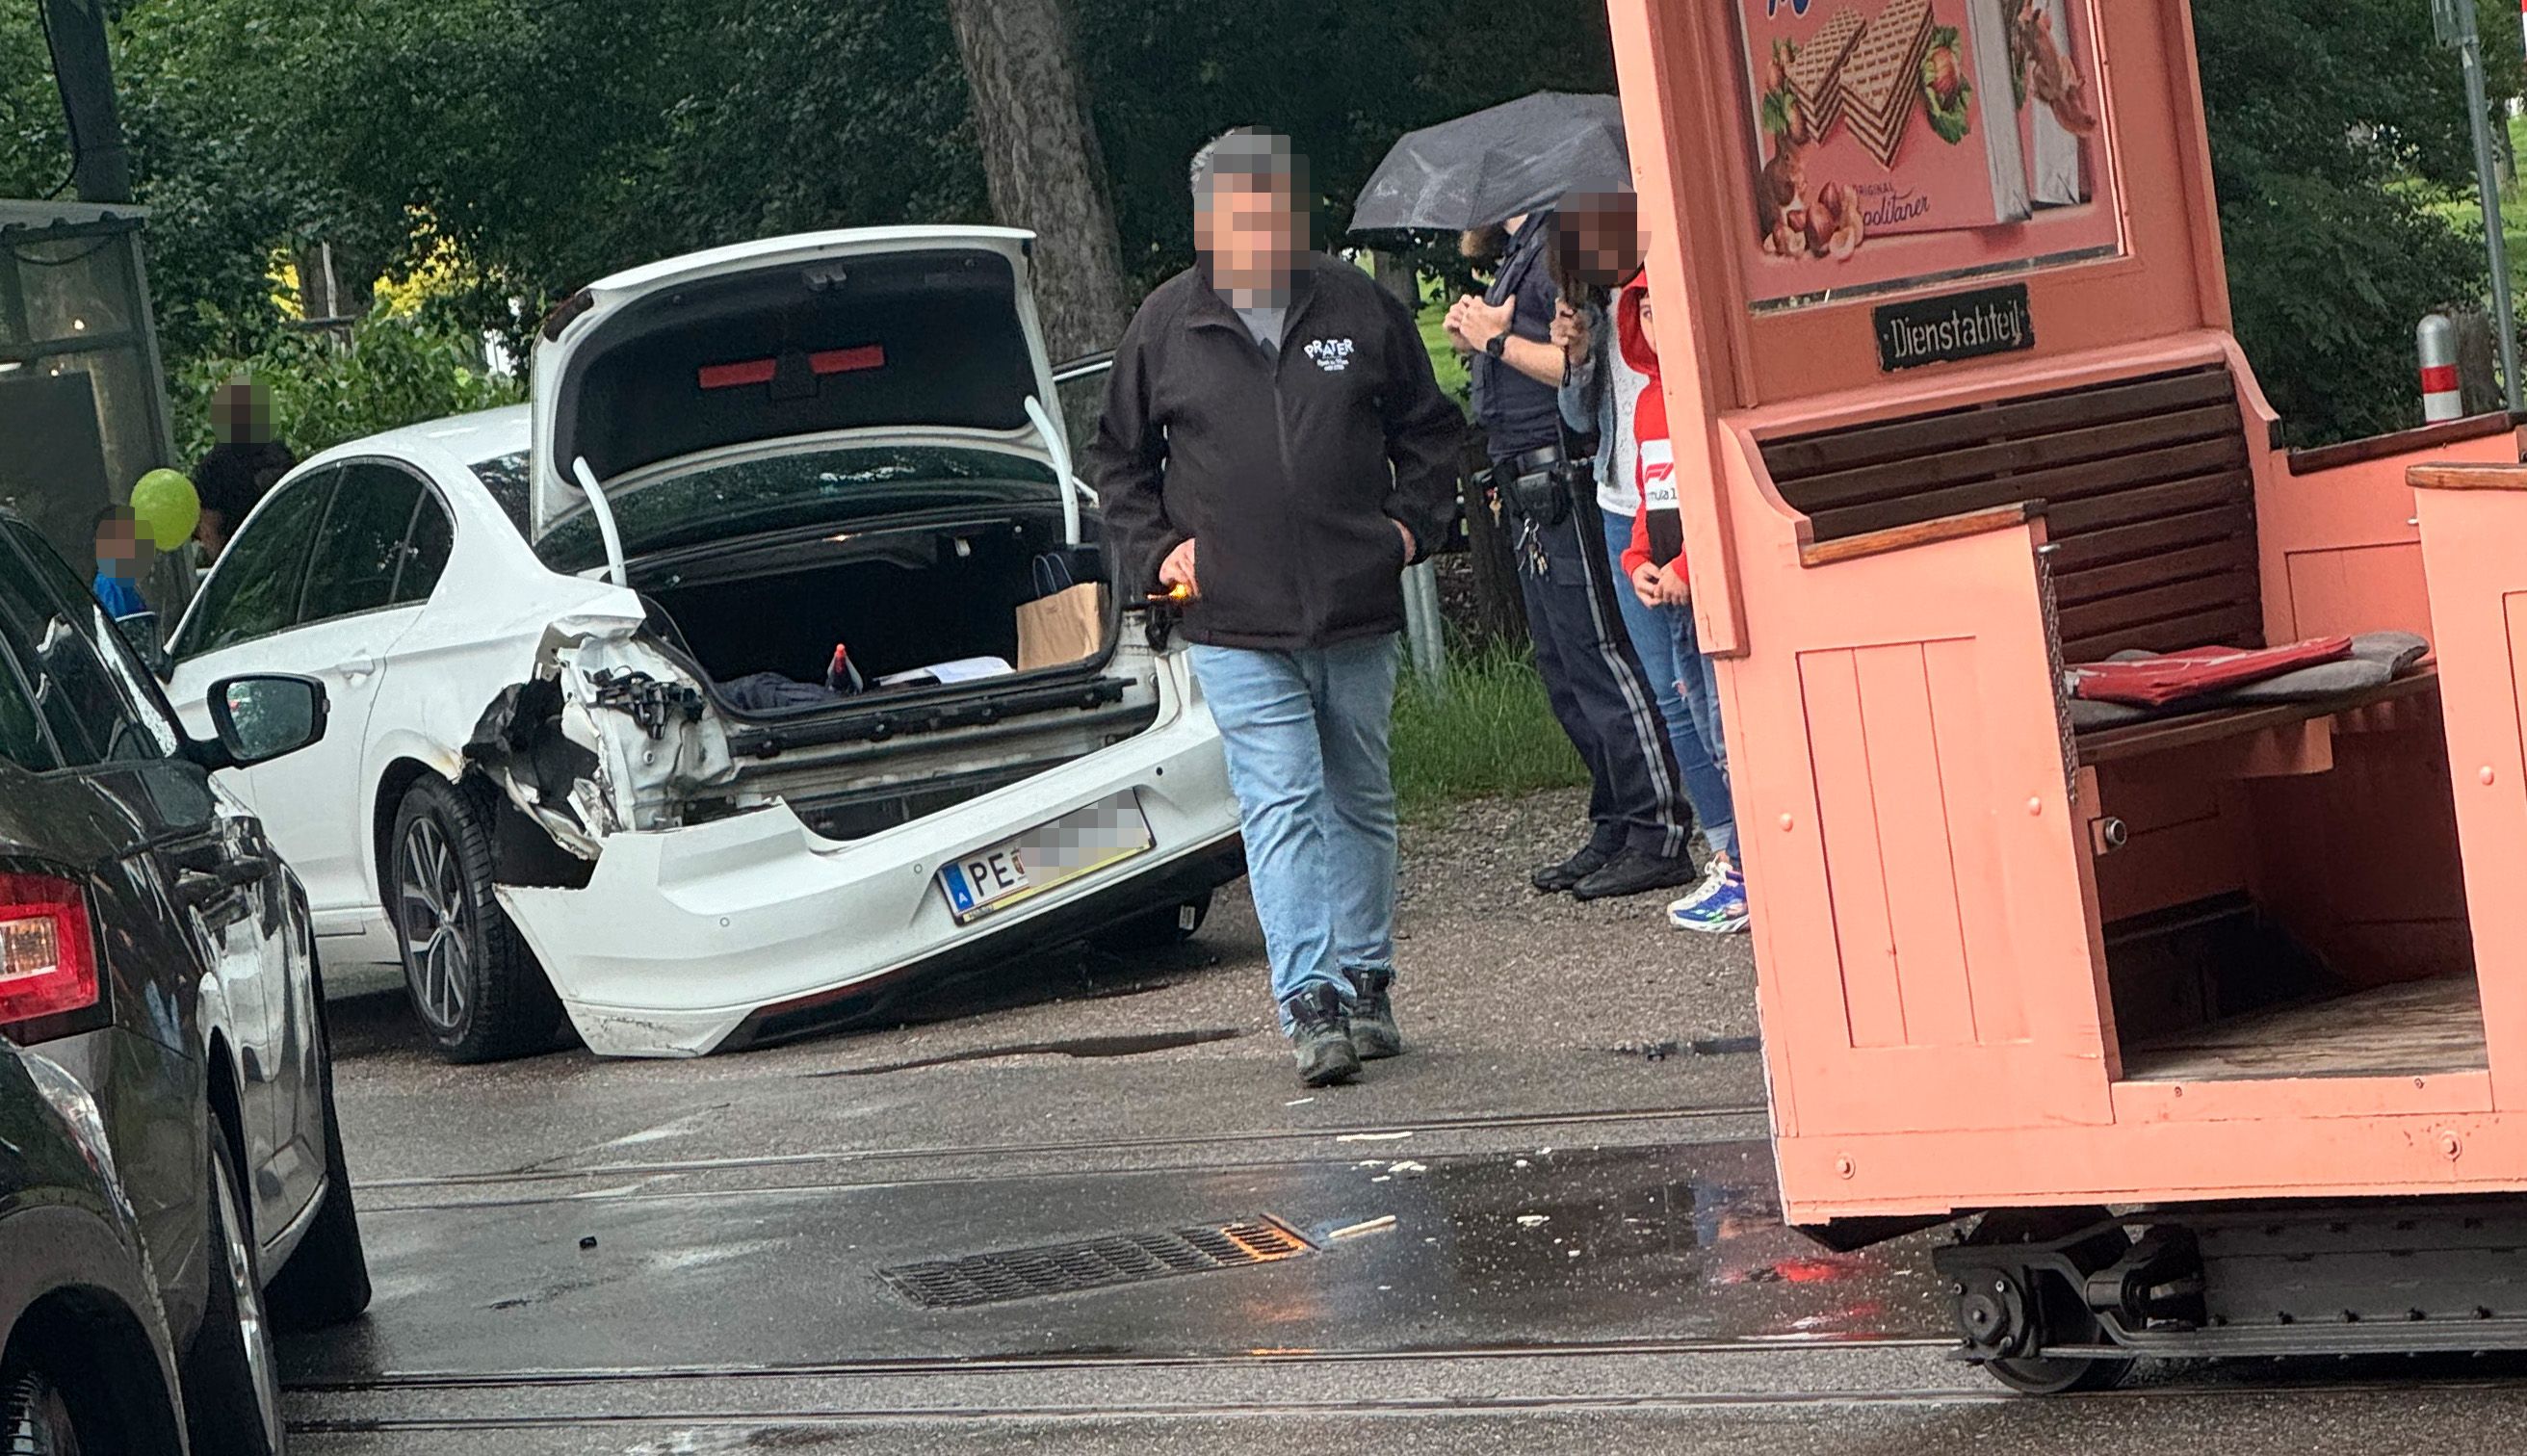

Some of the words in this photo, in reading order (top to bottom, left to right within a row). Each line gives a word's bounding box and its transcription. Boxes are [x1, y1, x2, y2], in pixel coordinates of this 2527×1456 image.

[1863, 187, 1931, 226] politaner
[1890, 299, 2021, 358] Dienstabteil
[1303, 338, 1355, 359] PRATER
[968, 852, 1014, 897] PE
[958, 892, 969, 904] A
